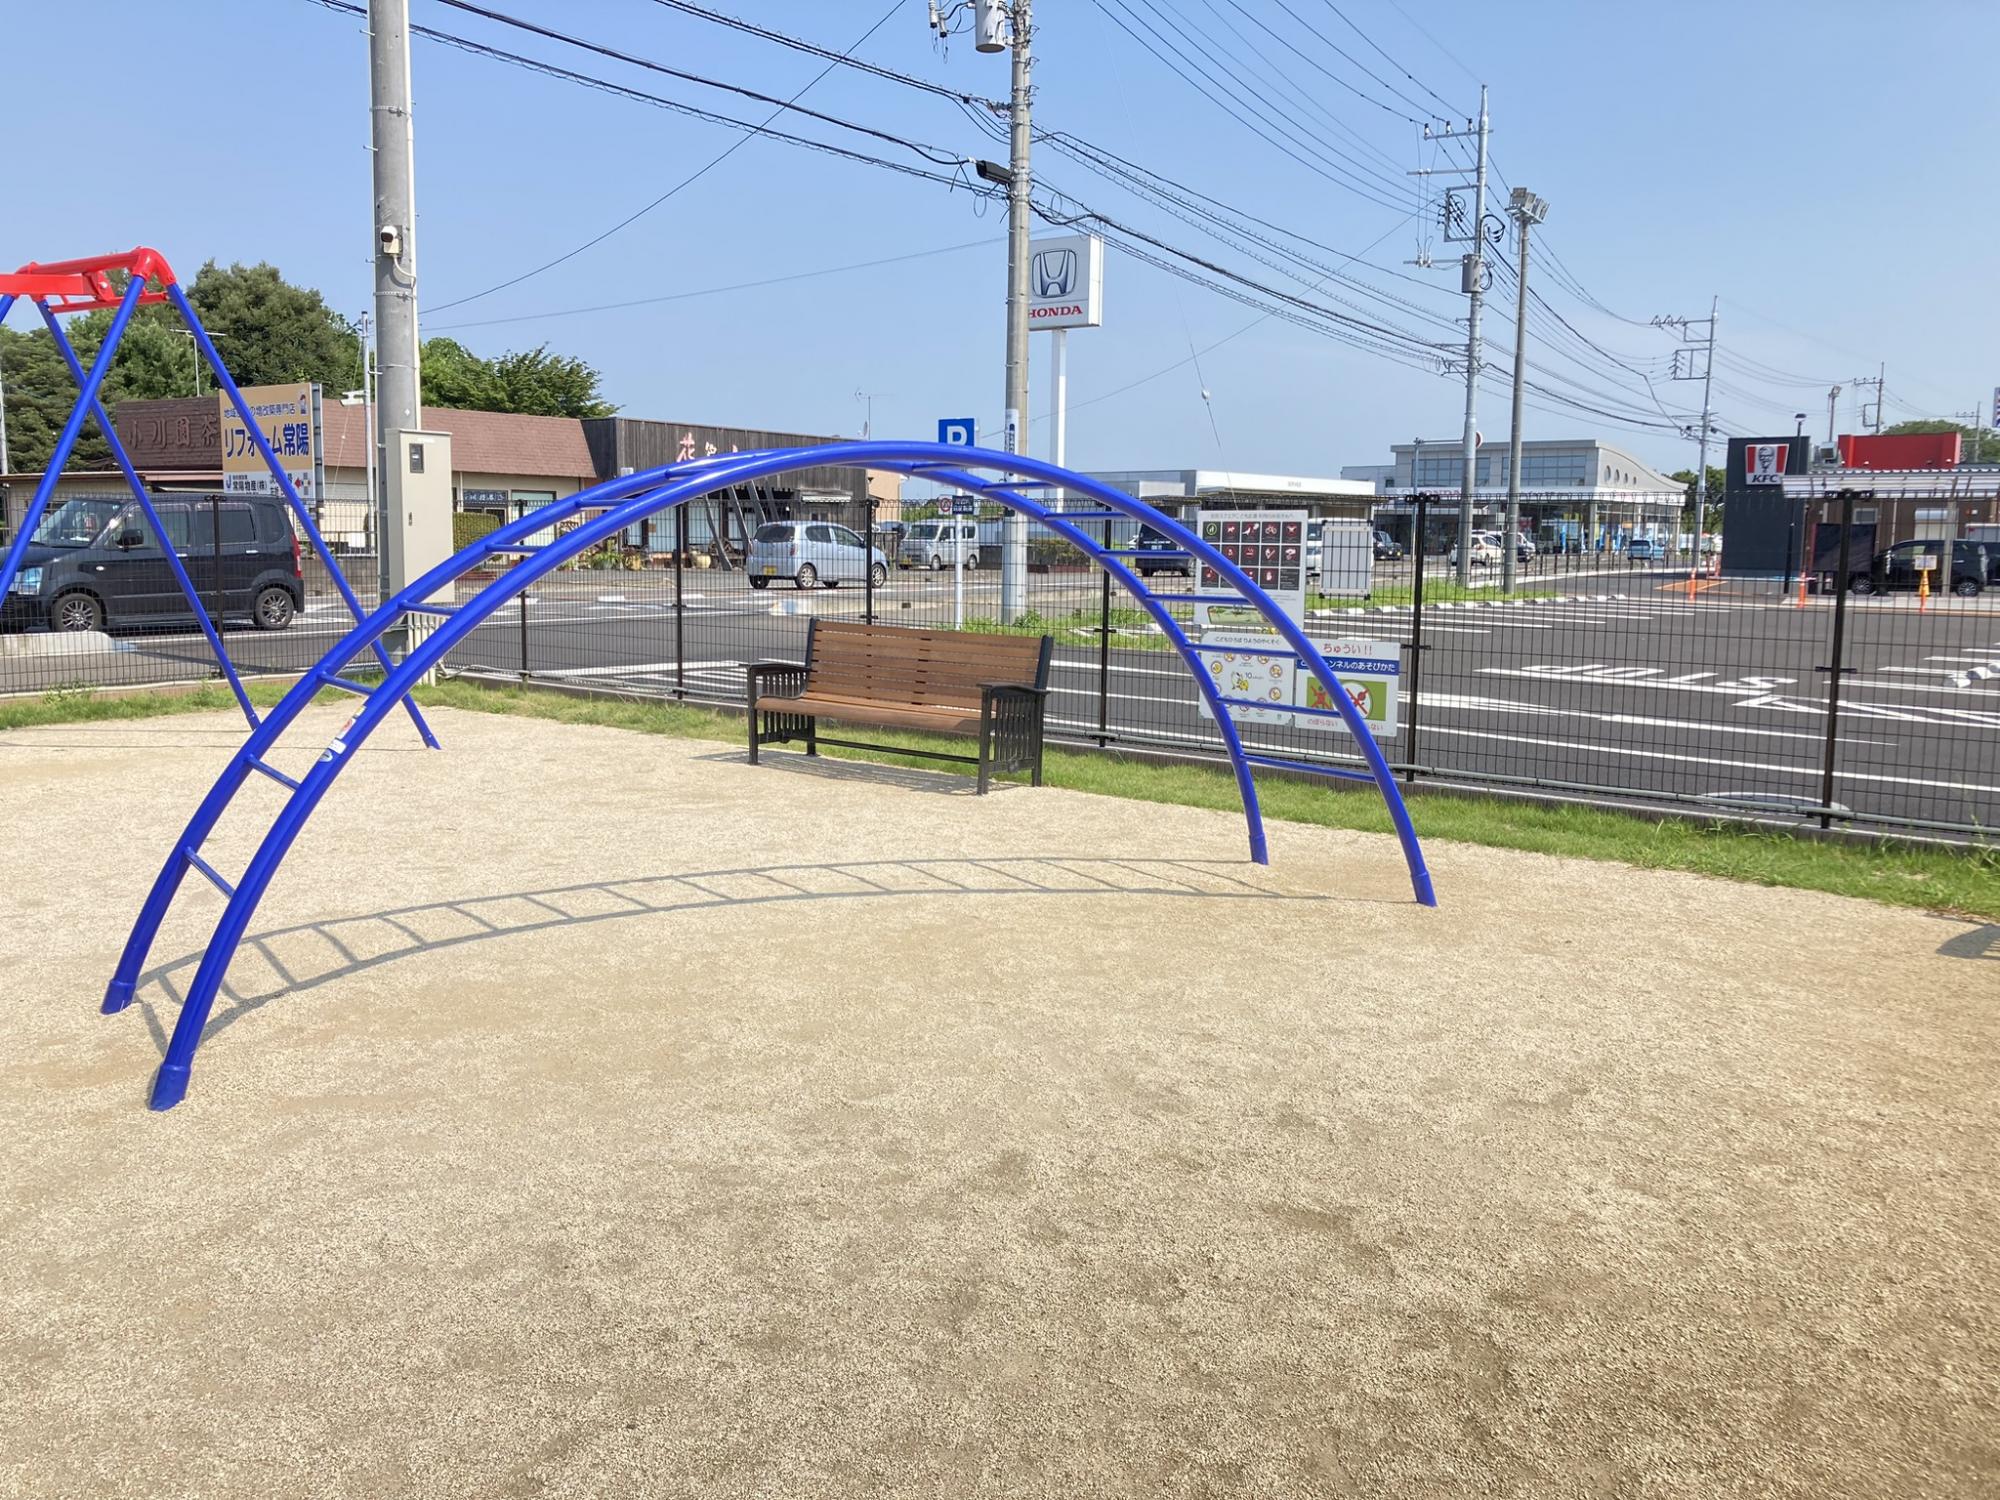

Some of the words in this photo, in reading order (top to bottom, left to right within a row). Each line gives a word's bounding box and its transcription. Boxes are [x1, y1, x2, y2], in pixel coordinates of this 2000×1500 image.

[1028, 305, 1083, 318] HONDA
[225, 423, 310, 458] リフォム常陽
[1752, 475, 1778, 483] KFC
[1520, 664, 1798, 690] STOP
